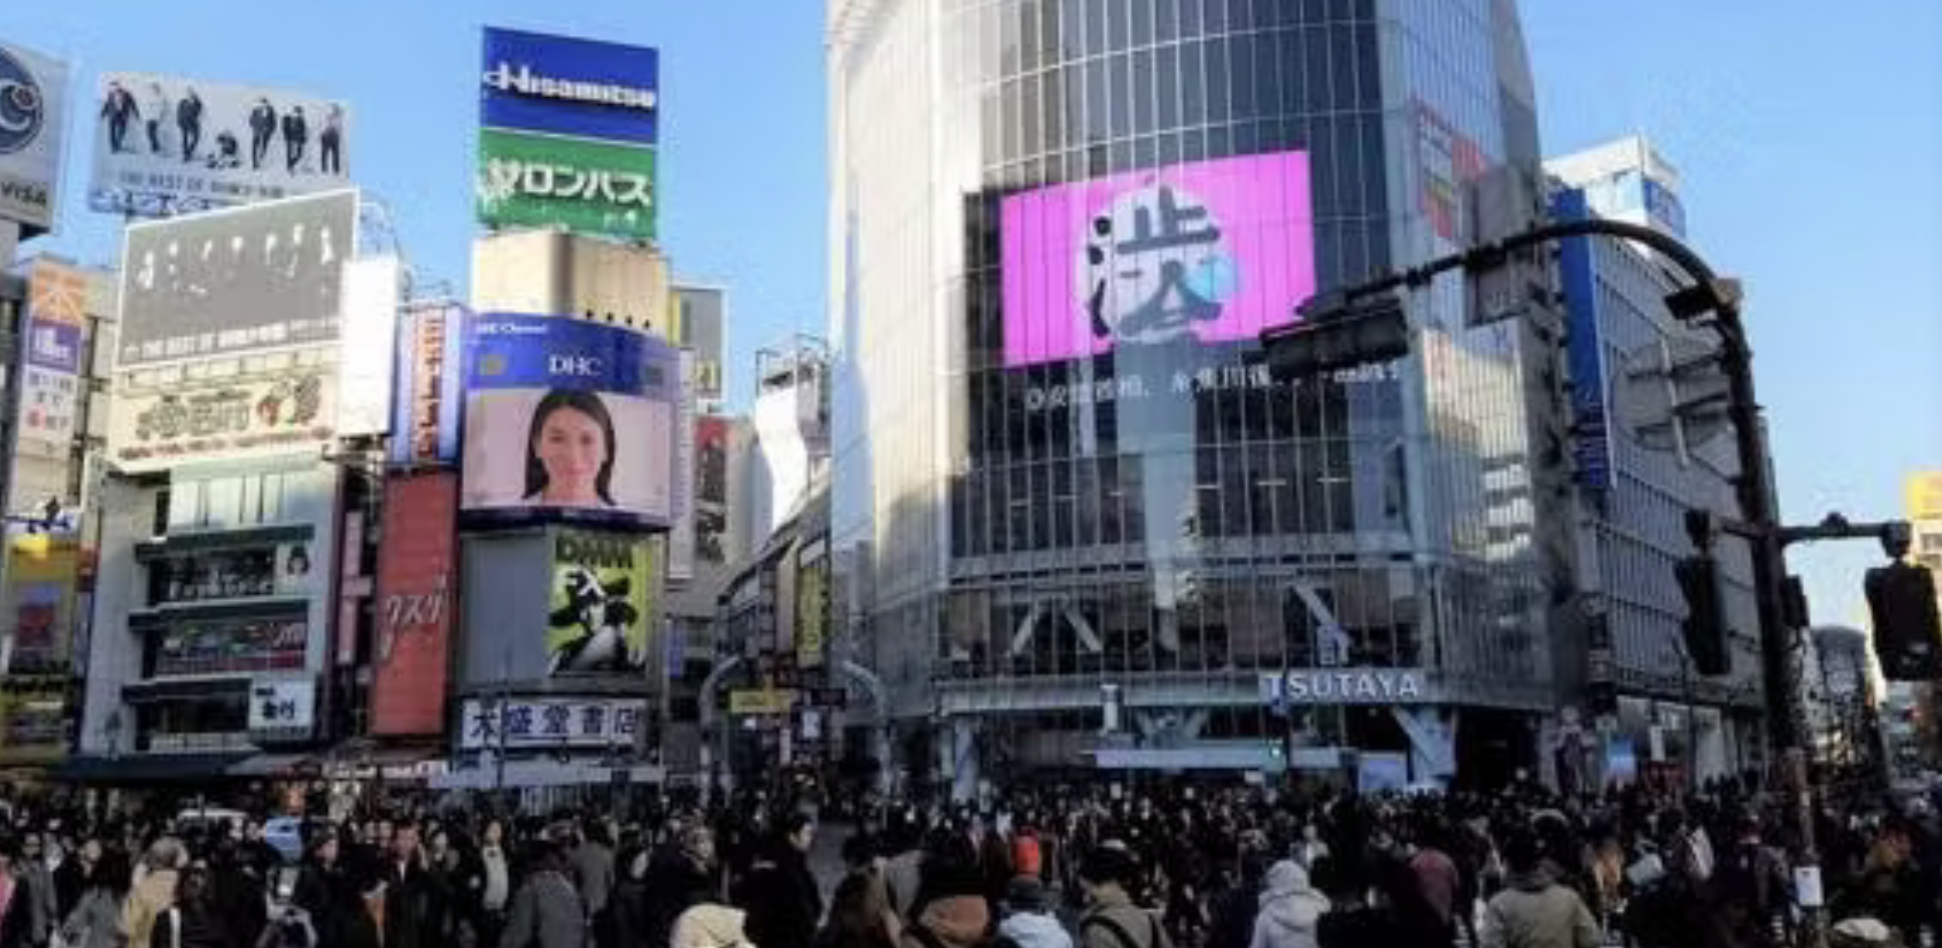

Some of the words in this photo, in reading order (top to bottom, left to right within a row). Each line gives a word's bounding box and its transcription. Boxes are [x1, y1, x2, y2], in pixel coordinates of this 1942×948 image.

[484, 62, 655, 107] Hisamitsu
[549, 356, 603, 376] DHC
[1265, 673, 1419, 698] TSUTAYA
